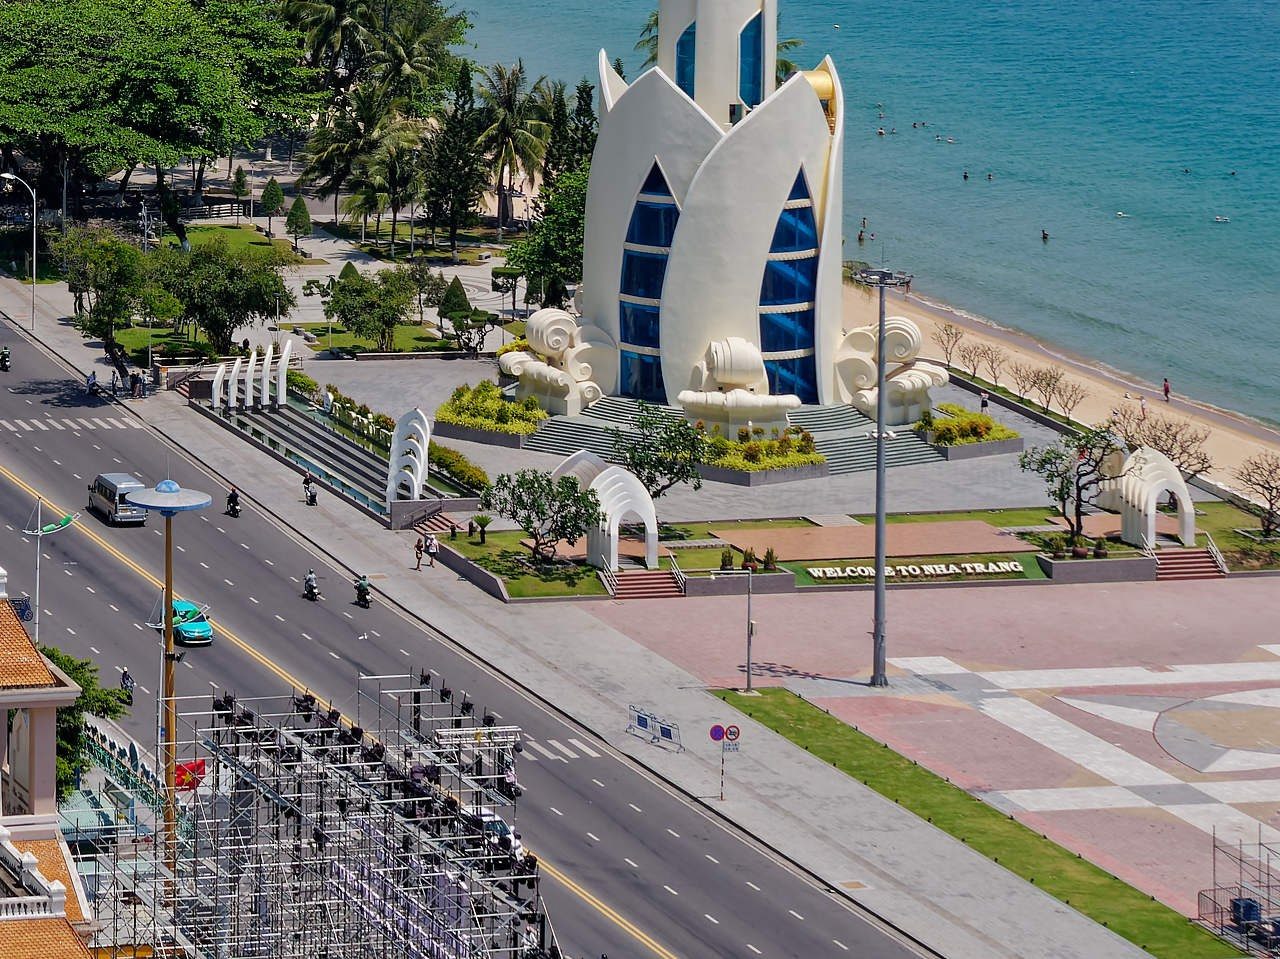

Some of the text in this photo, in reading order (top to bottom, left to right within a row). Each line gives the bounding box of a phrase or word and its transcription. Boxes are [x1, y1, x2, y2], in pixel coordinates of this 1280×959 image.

[895, 564, 920, 576] TO
[921, 563, 960, 576] NHA
[961, 561, 1024, 574] TRANG
